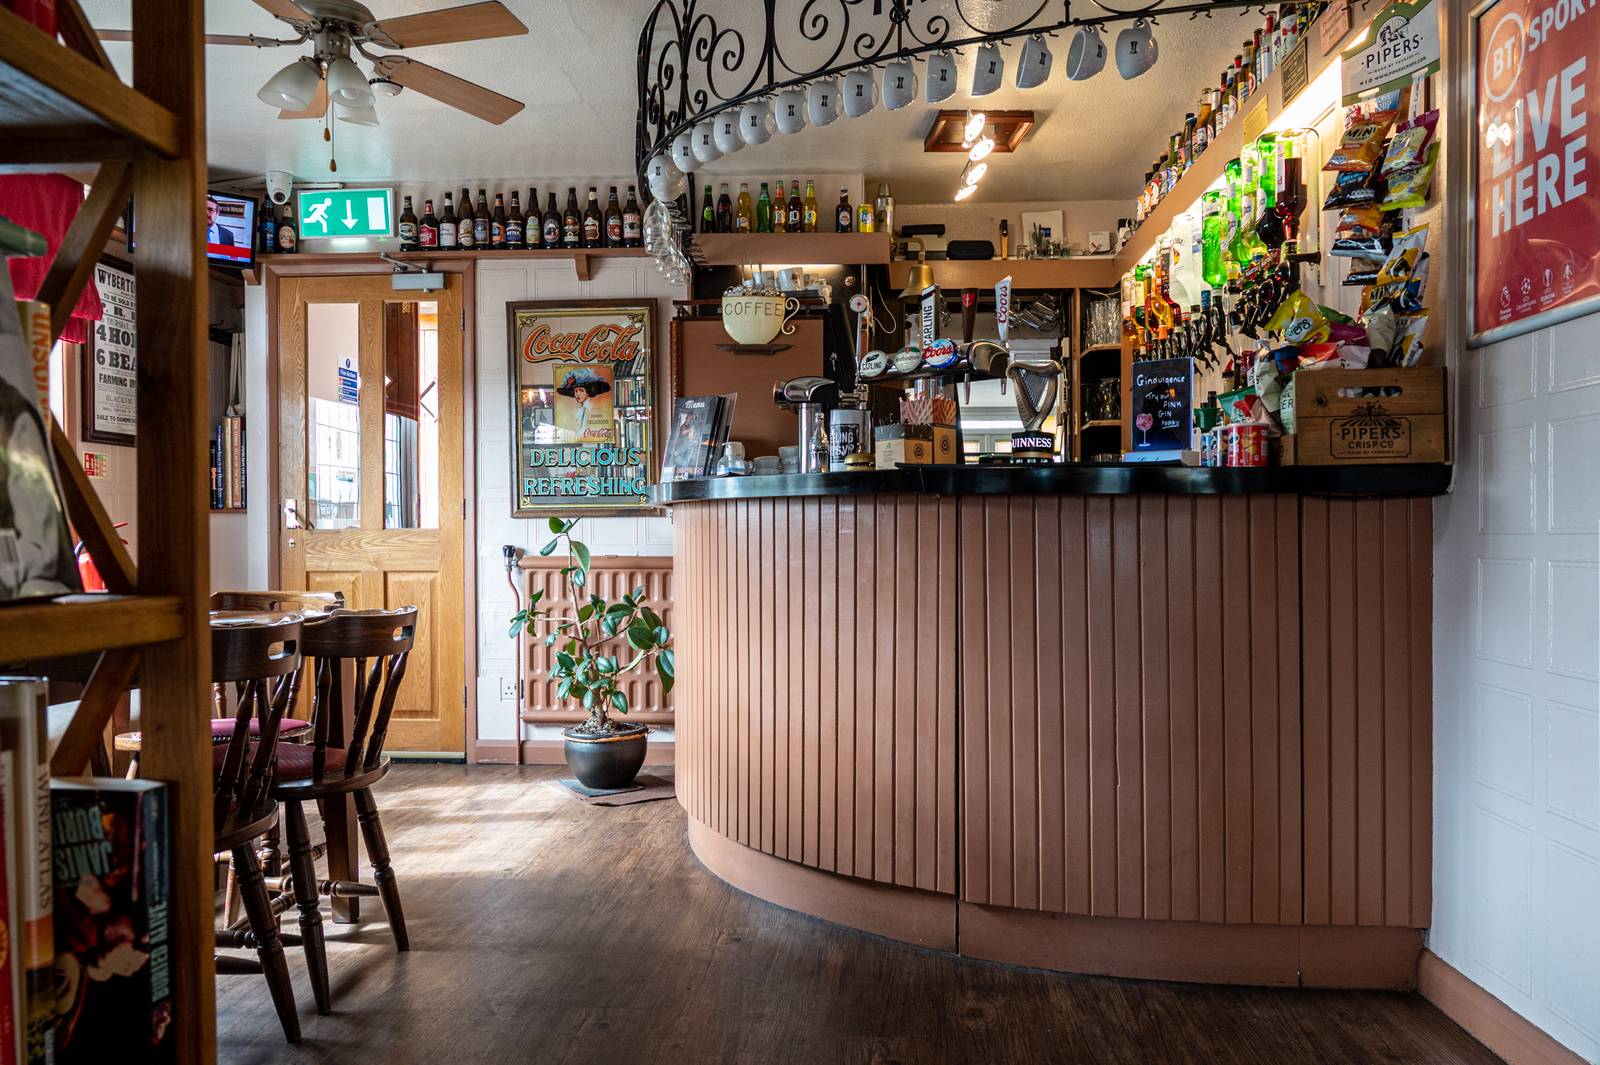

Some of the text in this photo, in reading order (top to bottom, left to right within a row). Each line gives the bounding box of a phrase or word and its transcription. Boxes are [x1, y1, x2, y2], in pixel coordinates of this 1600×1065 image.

[1366, 34, 1419, 68] PIPERS
[1493, 35, 1515, 80] BT
[1490, 56, 1587, 179] LIVE
[1491, 134, 1587, 238] HERE
[724, 302, 783, 316] COFFEE
[998, 286, 1008, 323] Coors
[96, 324, 106, 342] 4
[924, 305, 933, 346] CARLING
[522, 323, 644, 363] Coca-Cola
[922, 346, 953, 360] Coors
[96, 348, 106, 366] 6
[98, 374, 128, 388] FARMING
[1136, 374, 1185, 387] Gindulgence
[684, 400, 705, 408] Menu
[1158, 410, 1172, 418] GIN
[1163, 400, 1182, 408] PINK
[1342, 427, 1400, 440] PIPERS
[1348, 441, 1378, 449] CRISP
[530, 447, 641, 467] DELICIOUS
[523, 477, 646, 497] REFRESHING
[37, 770, 51, 909] WINE ATLAS
[57, 840, 113, 880] JANIS
[147, 901, 168, 944] ALIVE
[150, 943, 169, 1003] BURIED
